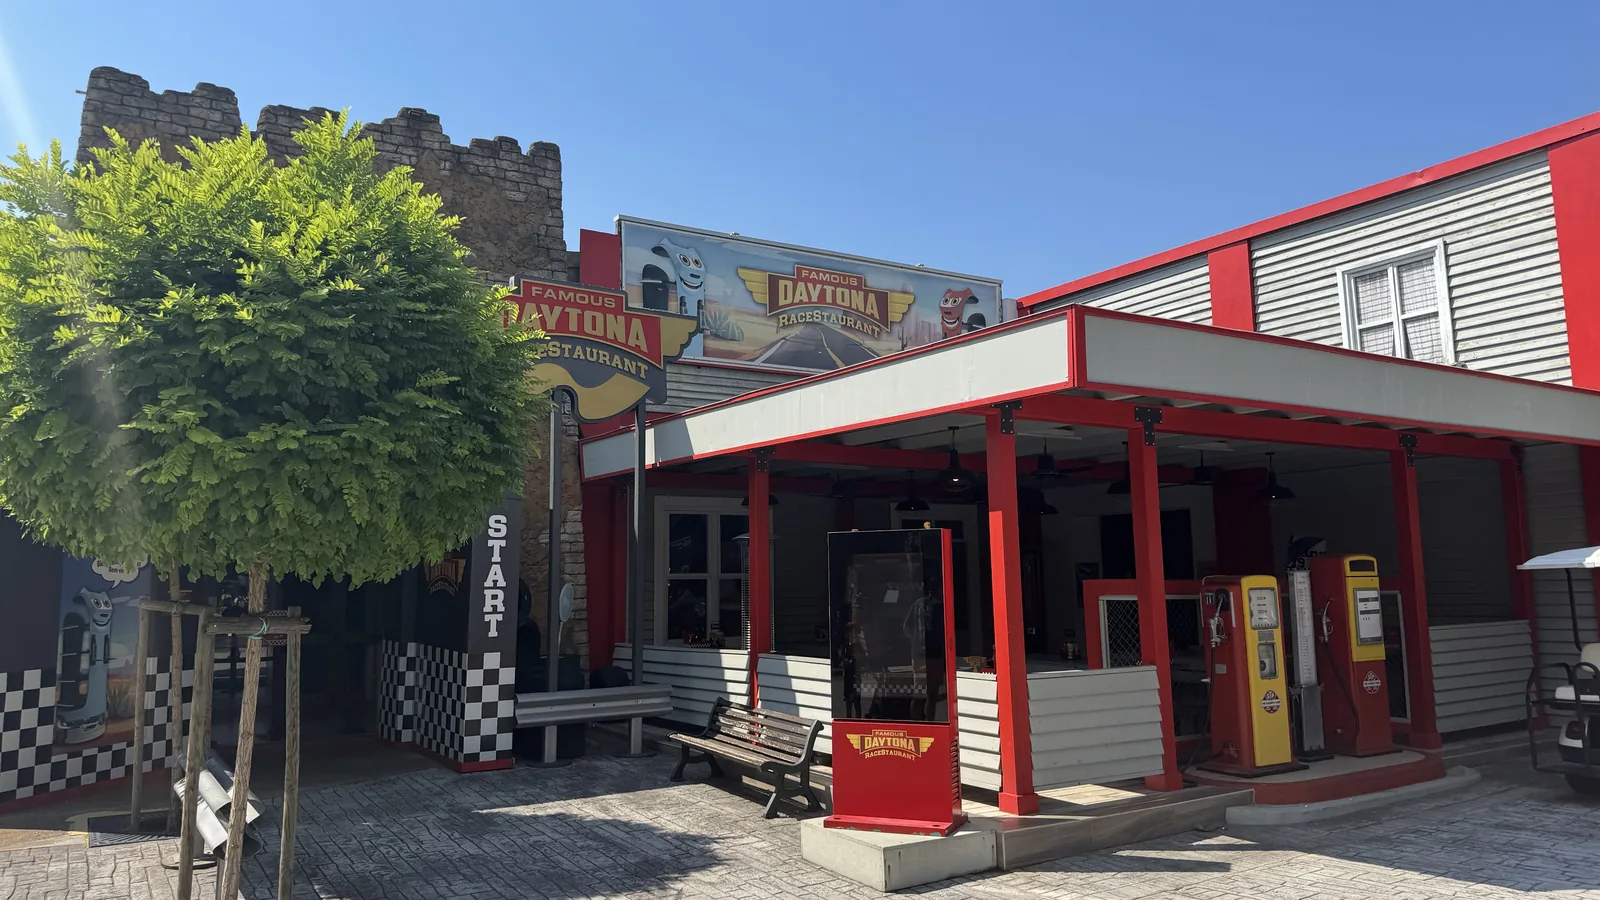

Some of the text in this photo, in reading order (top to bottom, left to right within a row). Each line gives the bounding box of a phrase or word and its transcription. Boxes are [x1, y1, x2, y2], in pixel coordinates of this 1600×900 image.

[801, 270, 858, 286] FAMOUS
[531, 286, 616, 308] FAMOUS
[778, 280, 880, 320] DAYTONA
[778, 309, 880, 338] RACESTAURANT
[537, 341, 649, 379] ESTAURANT
[483, 514, 507, 637] START
[864, 736, 916, 751] DAYTONA
[864, 749, 916, 761] RACESTAURANT
